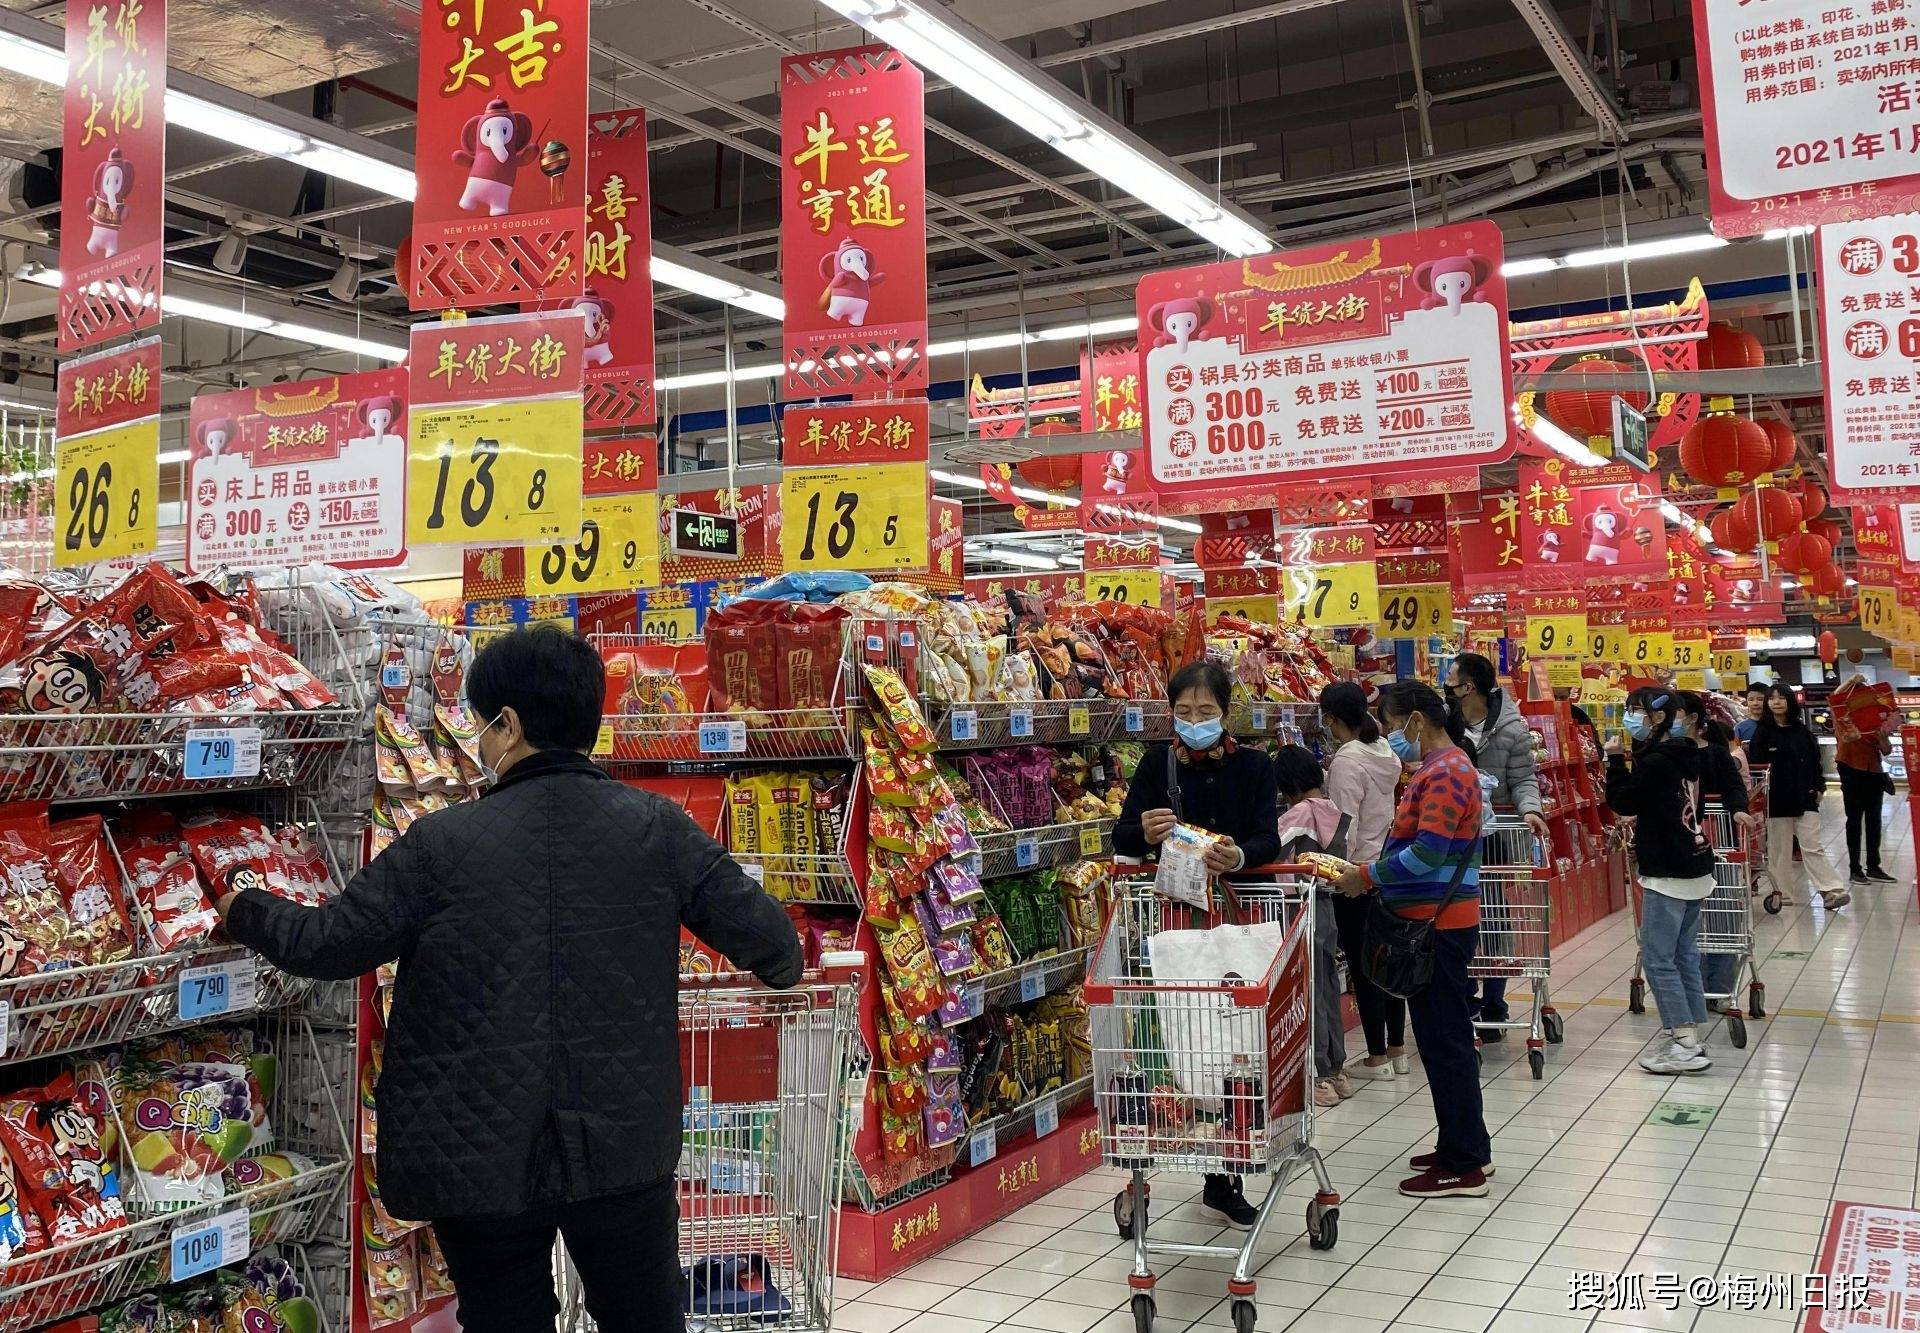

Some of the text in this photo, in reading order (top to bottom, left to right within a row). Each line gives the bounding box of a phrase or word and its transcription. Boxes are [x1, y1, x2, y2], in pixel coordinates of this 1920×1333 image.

[445, 9, 558, 92] 大吉
[794, 111, 910, 185] 牛运
[802, 167, 906, 232] 亨通
[1751, 183, 1878, 213] 2021 辛丑年
[444, 226, 463, 236] NEW
[502, 217, 551, 230] GOODLUCK
[1841, 290, 1905, 314] 免费送
[428, 333, 567, 391] 年货大街
[1168, 348, 1410, 392] 买 锅具分类商品 单张收银小票
[69, 361, 151, 421] 年货大街
[1294, 378, 1362, 407] 免费送
[1845, 376, 1911, 398] 免费送
[799, 416, 914, 455] 年货大街
[1297, 413, 1364, 440] 免费送
[583, 449, 644, 482] 大街
[199, 479, 217, 506] 买
[225, 470, 311, 503] 床上用品
[1525, 479, 1575, 508] 牛运
[288, 502, 310, 531] 送
[932, 527, 962, 552] PROMOTION
[1092, 544, 1153, 564] 年货大街
[648, 589, 693, 604] 天天便宜
